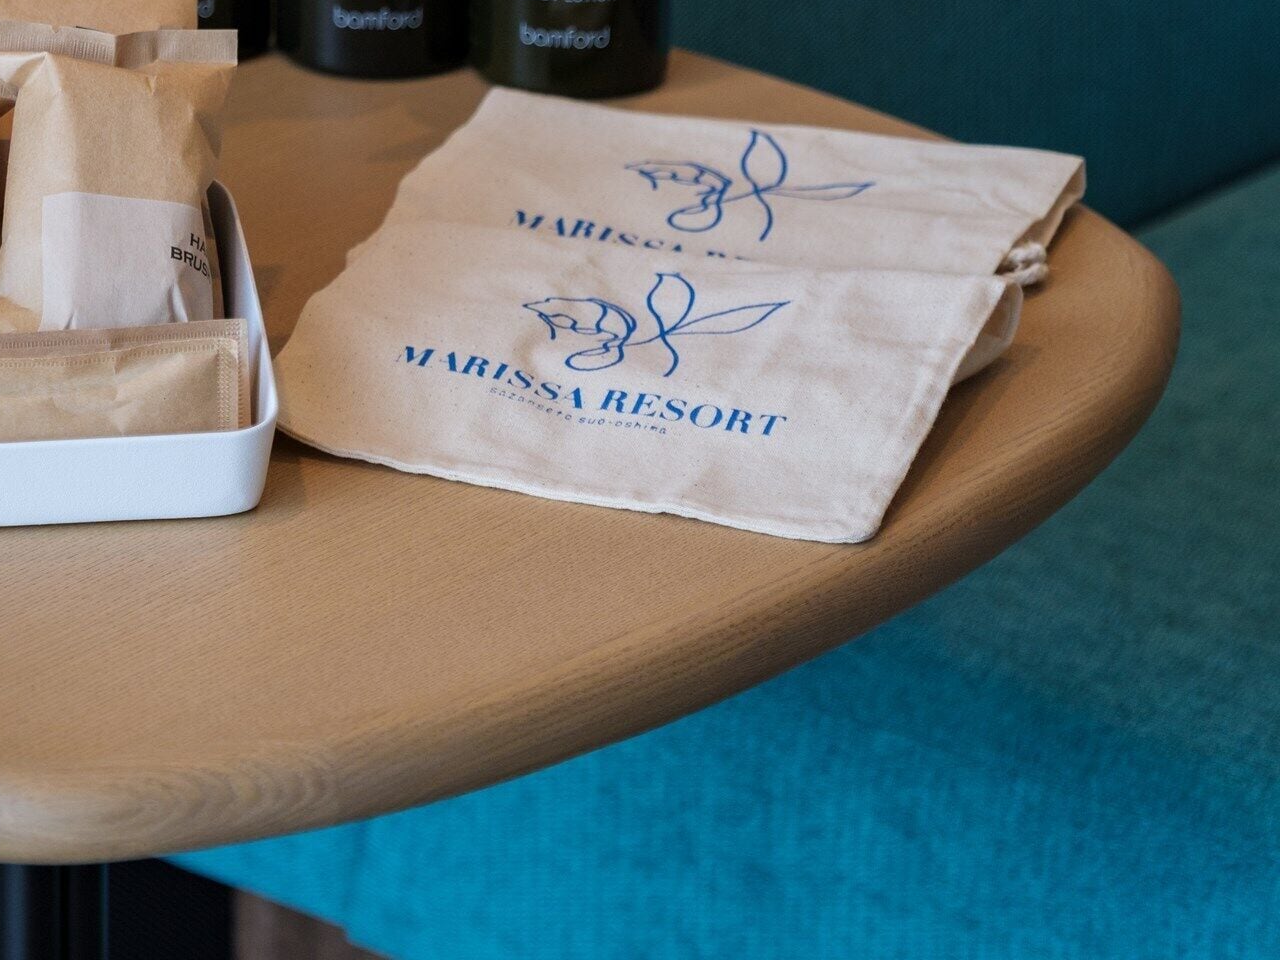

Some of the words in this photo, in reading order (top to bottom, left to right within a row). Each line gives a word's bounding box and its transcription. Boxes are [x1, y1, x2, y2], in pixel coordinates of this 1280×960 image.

[331, 3, 424, 30] bamford
[520, 19, 612, 50] bamford
[171, 246, 211, 277] BRUS
[396, 345, 583, 409] MARISSA
[600, 389, 788, 437] RESORT
